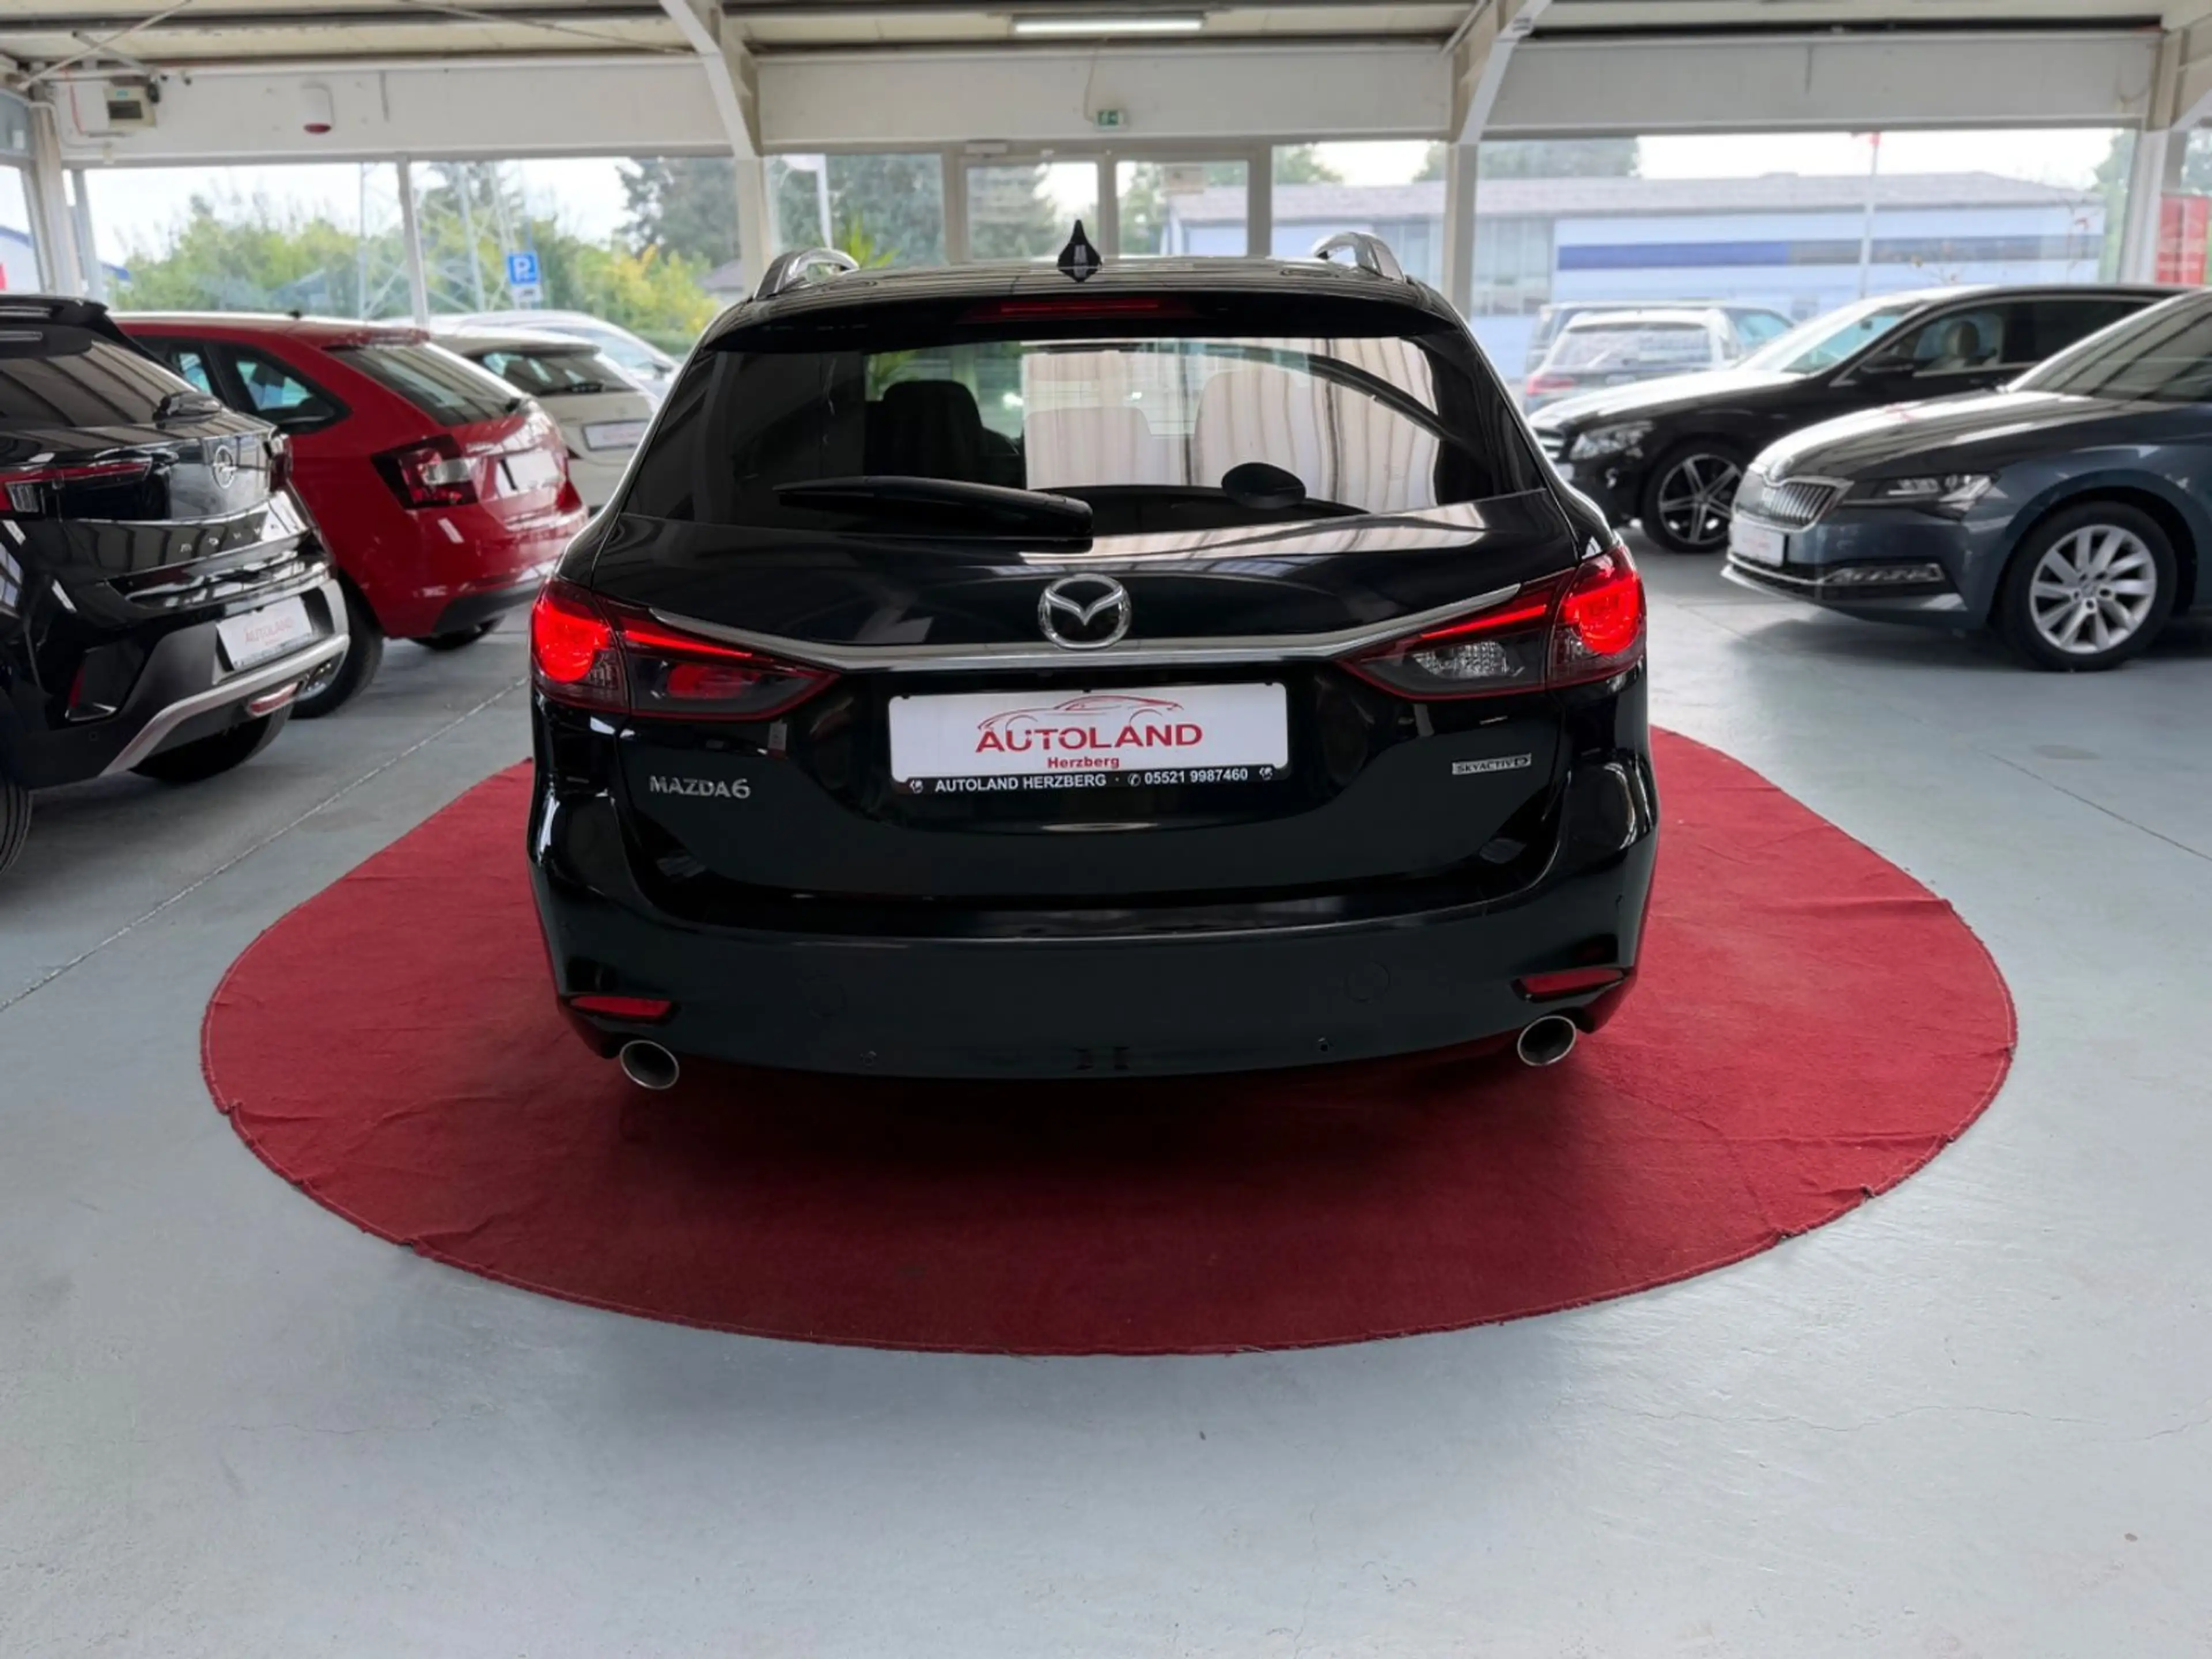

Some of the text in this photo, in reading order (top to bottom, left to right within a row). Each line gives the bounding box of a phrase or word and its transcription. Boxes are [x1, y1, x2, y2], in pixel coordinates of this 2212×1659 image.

[513, 258, 531, 282] P
[975, 724, 1203, 753] AUTOLAND
[1047, 756, 1120, 769] Herzberg
[650, 775, 751, 799] MAZDA6
[934, 767, 1248, 793] AUTOLAND HERZBERG 05521 9987460
